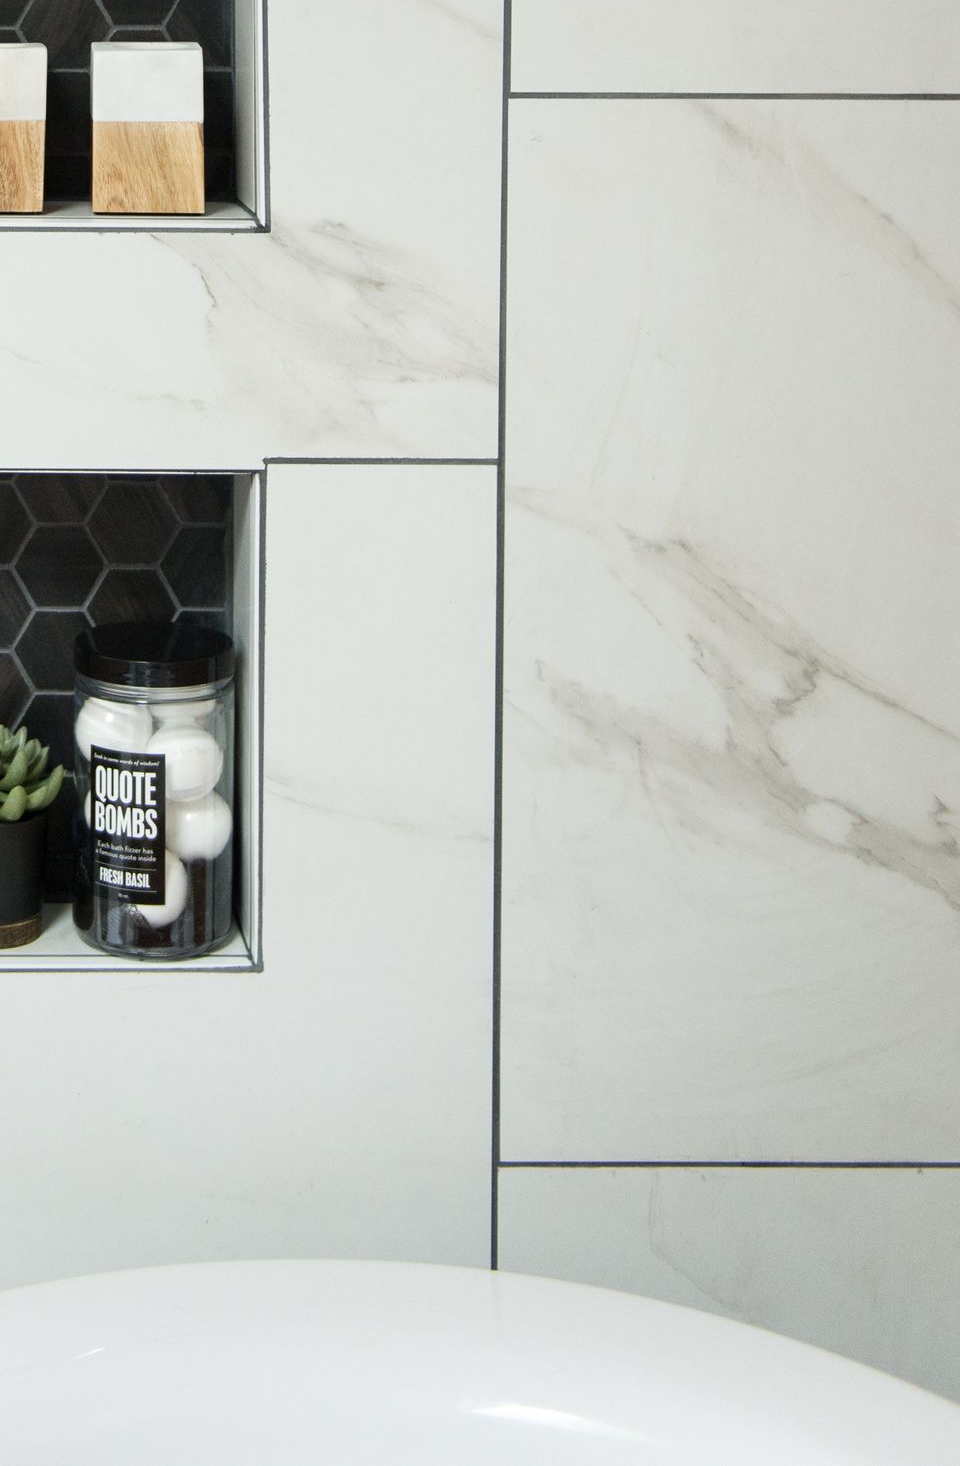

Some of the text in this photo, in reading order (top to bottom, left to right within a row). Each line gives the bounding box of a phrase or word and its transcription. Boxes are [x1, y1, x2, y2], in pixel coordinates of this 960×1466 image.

[95, 765, 157, 805] QUOTE
[95, 800, 158, 839] BOMBS
[97, 840, 110, 849] Each
[111, 843, 124, 851] bath
[124, 845, 141, 854] fizzer
[99, 847, 118, 857] famous
[99, 866, 151, 888] FRESH BASIL
